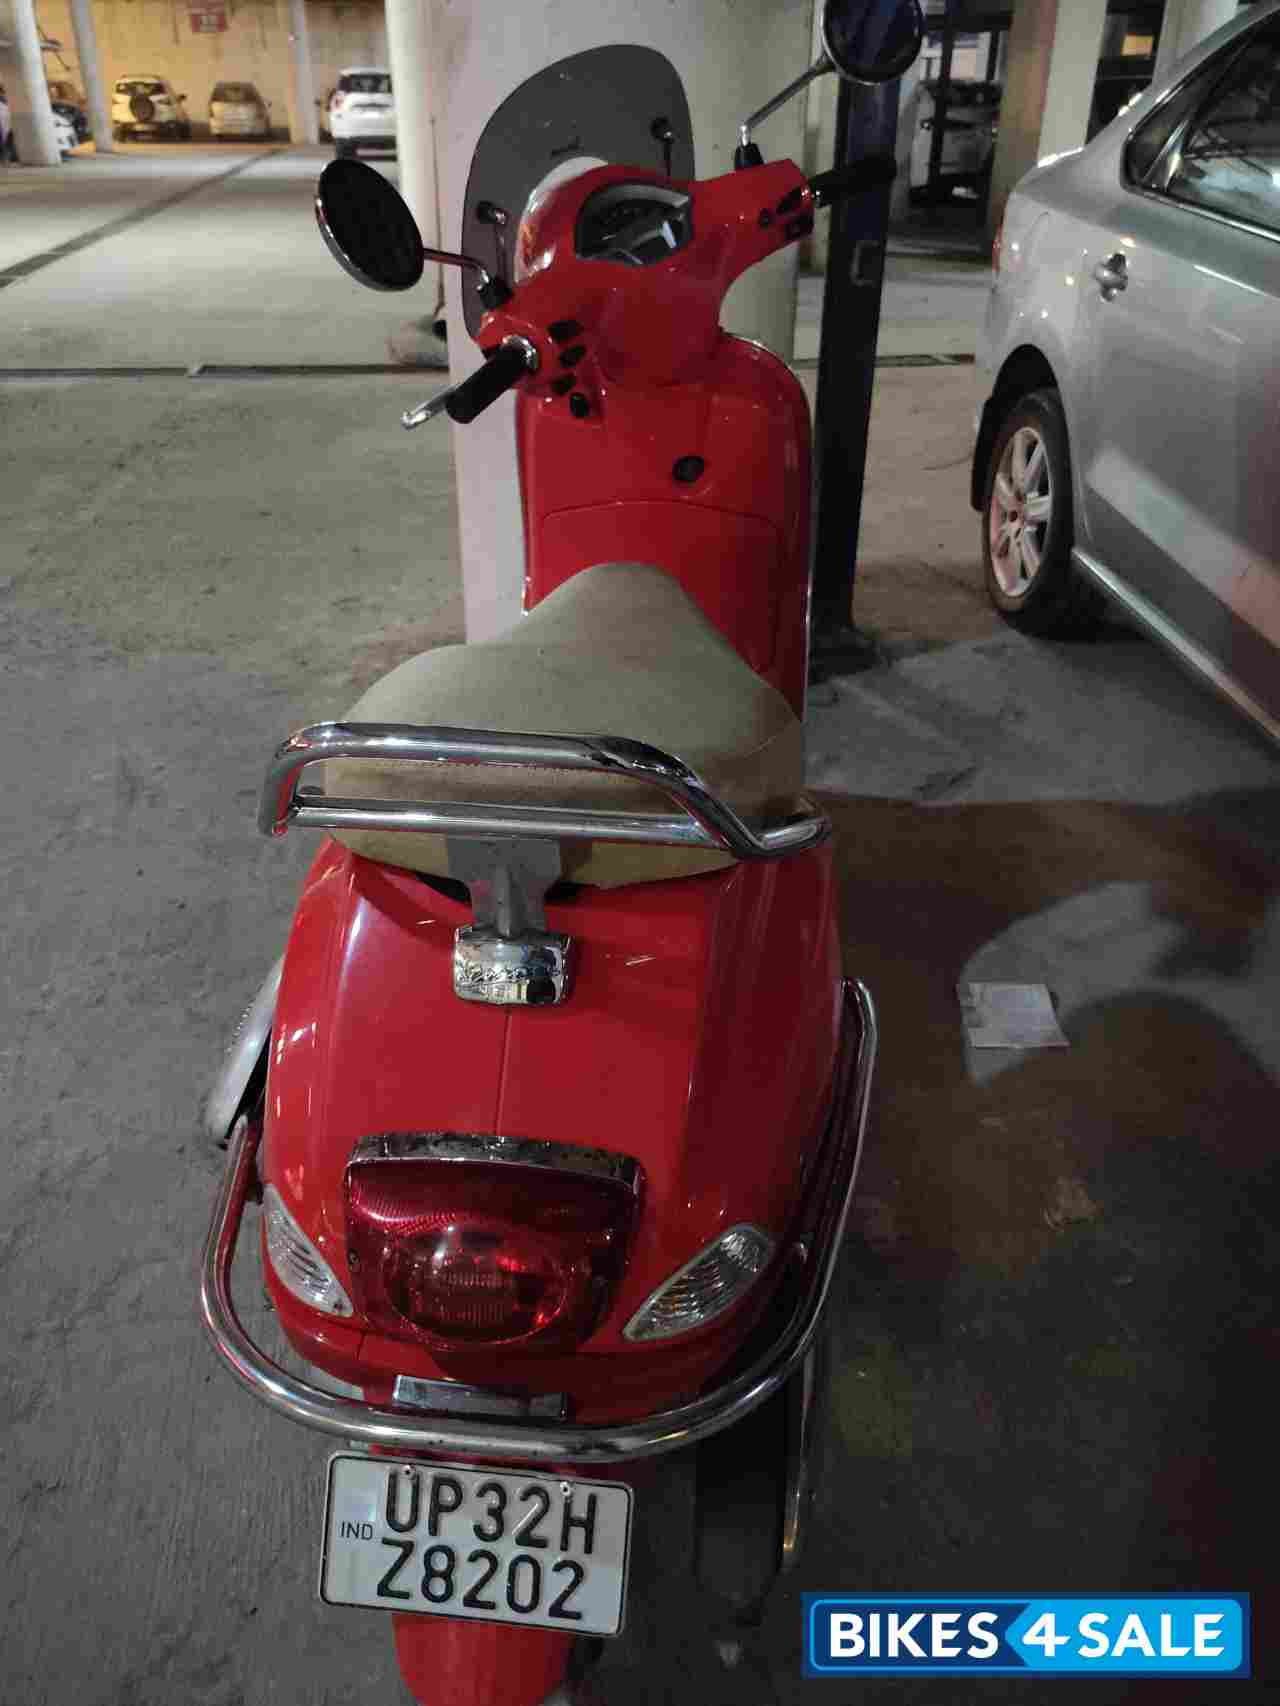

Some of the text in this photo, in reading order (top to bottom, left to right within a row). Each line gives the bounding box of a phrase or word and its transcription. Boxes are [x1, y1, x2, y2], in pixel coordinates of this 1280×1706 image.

[340, 1521, 374, 1541] IND
[386, 1467, 597, 1554] UP32H
[376, 1537, 585, 1620] Z8202
